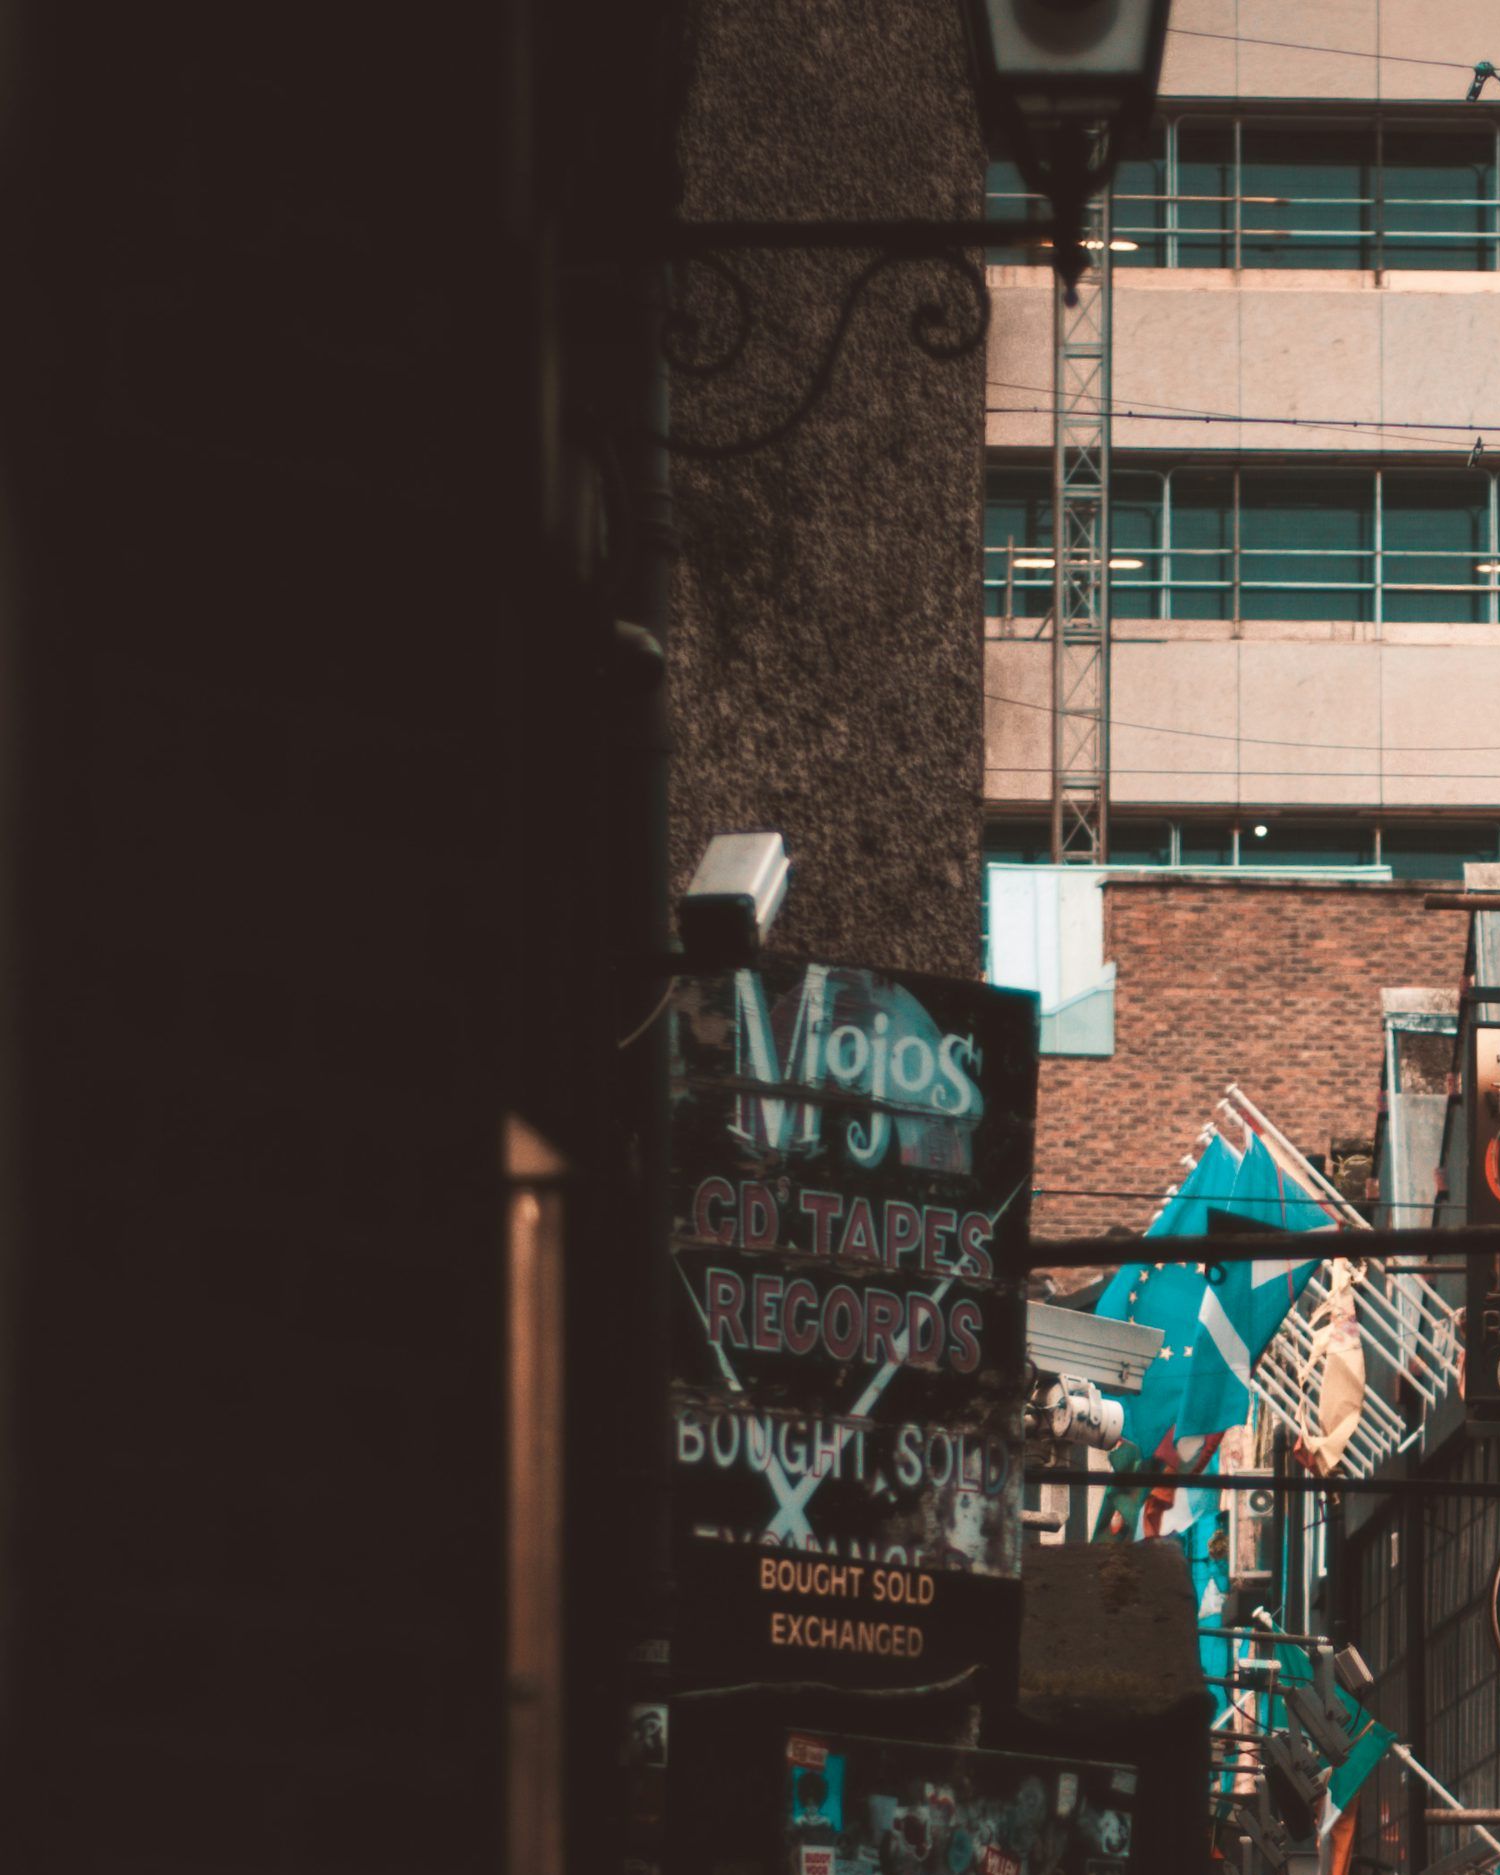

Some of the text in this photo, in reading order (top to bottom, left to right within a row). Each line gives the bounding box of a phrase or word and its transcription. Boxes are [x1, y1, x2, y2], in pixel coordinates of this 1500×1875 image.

[727, 962, 983, 1167] Mojos
[801, 1190, 993, 1280] TAPES
[707, 1267, 983, 1374] RECORDS
[896, 1422, 1009, 1496] SOLD
[760, 1557, 935, 1606] BOUGHT SOLD
[771, 1611, 924, 1658] EXCHANGED
